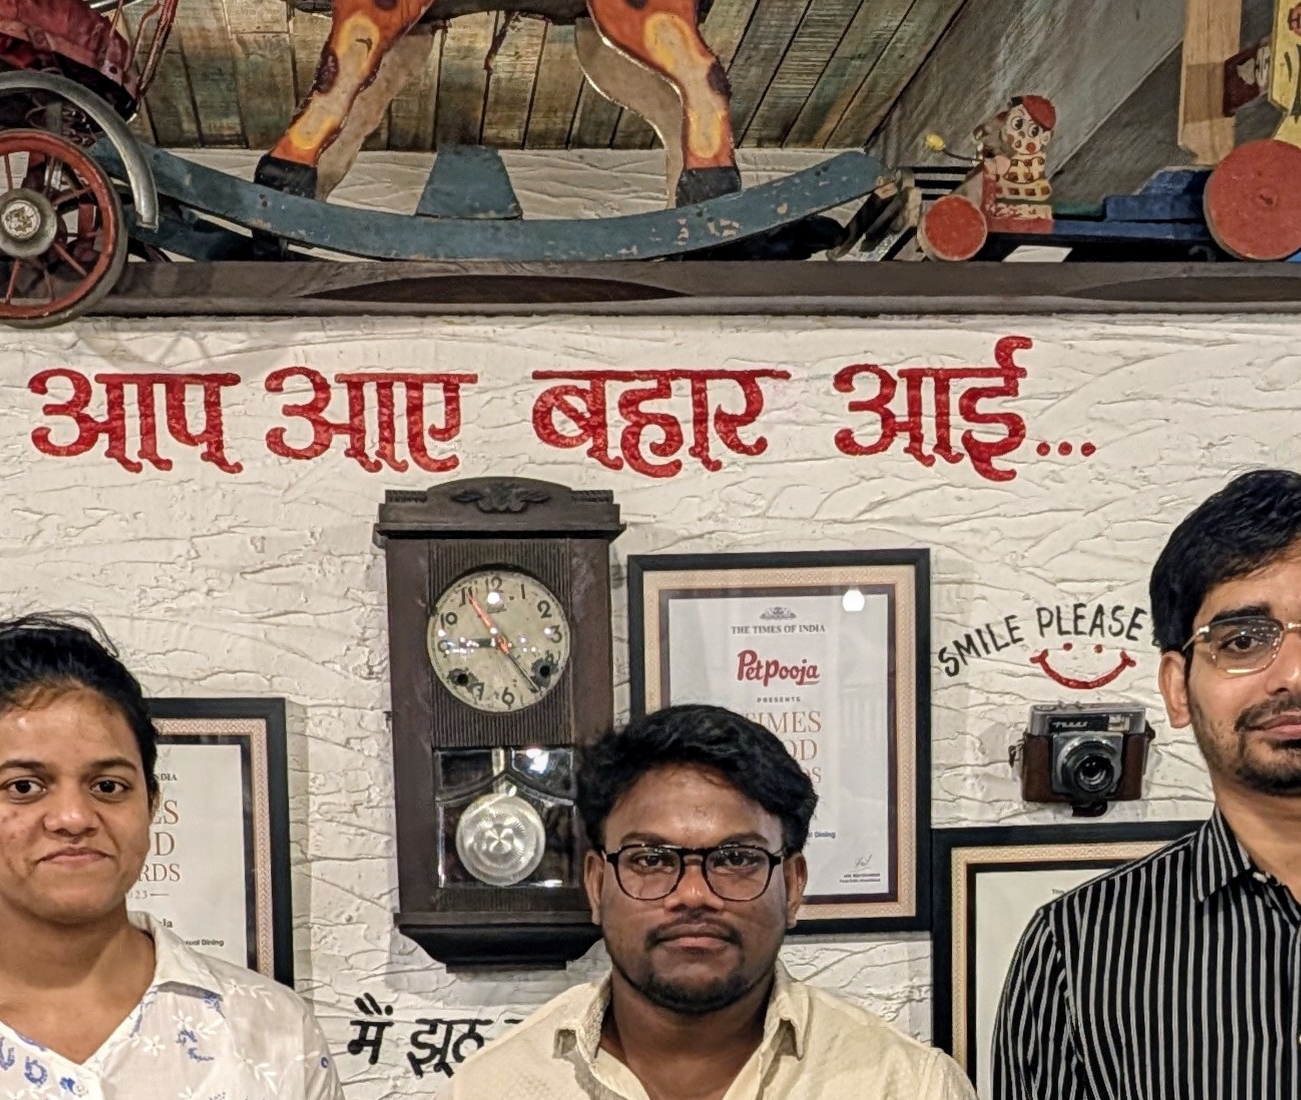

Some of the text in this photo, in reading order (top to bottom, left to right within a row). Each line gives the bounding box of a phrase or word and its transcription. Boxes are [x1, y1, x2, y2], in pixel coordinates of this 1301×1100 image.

[27, 368, 243, 474] आप
[265, 366, 479, 474] आए
[532, 368, 791, 478] बहार
[537, 600, 552, 619] 2
[731, 624, 826, 634] THE TIMES OF INDIA
[938, 603, 1148, 677] SMILE PLEASE
[737, 650, 820, 687] Petpooja
[502, 687, 515, 706] 6
[815, 831, 836, 839] Dining
[138, 863, 181, 882] RDS
[202, 939, 225, 947] Dining
[348, 992, 395, 1065] मैं
